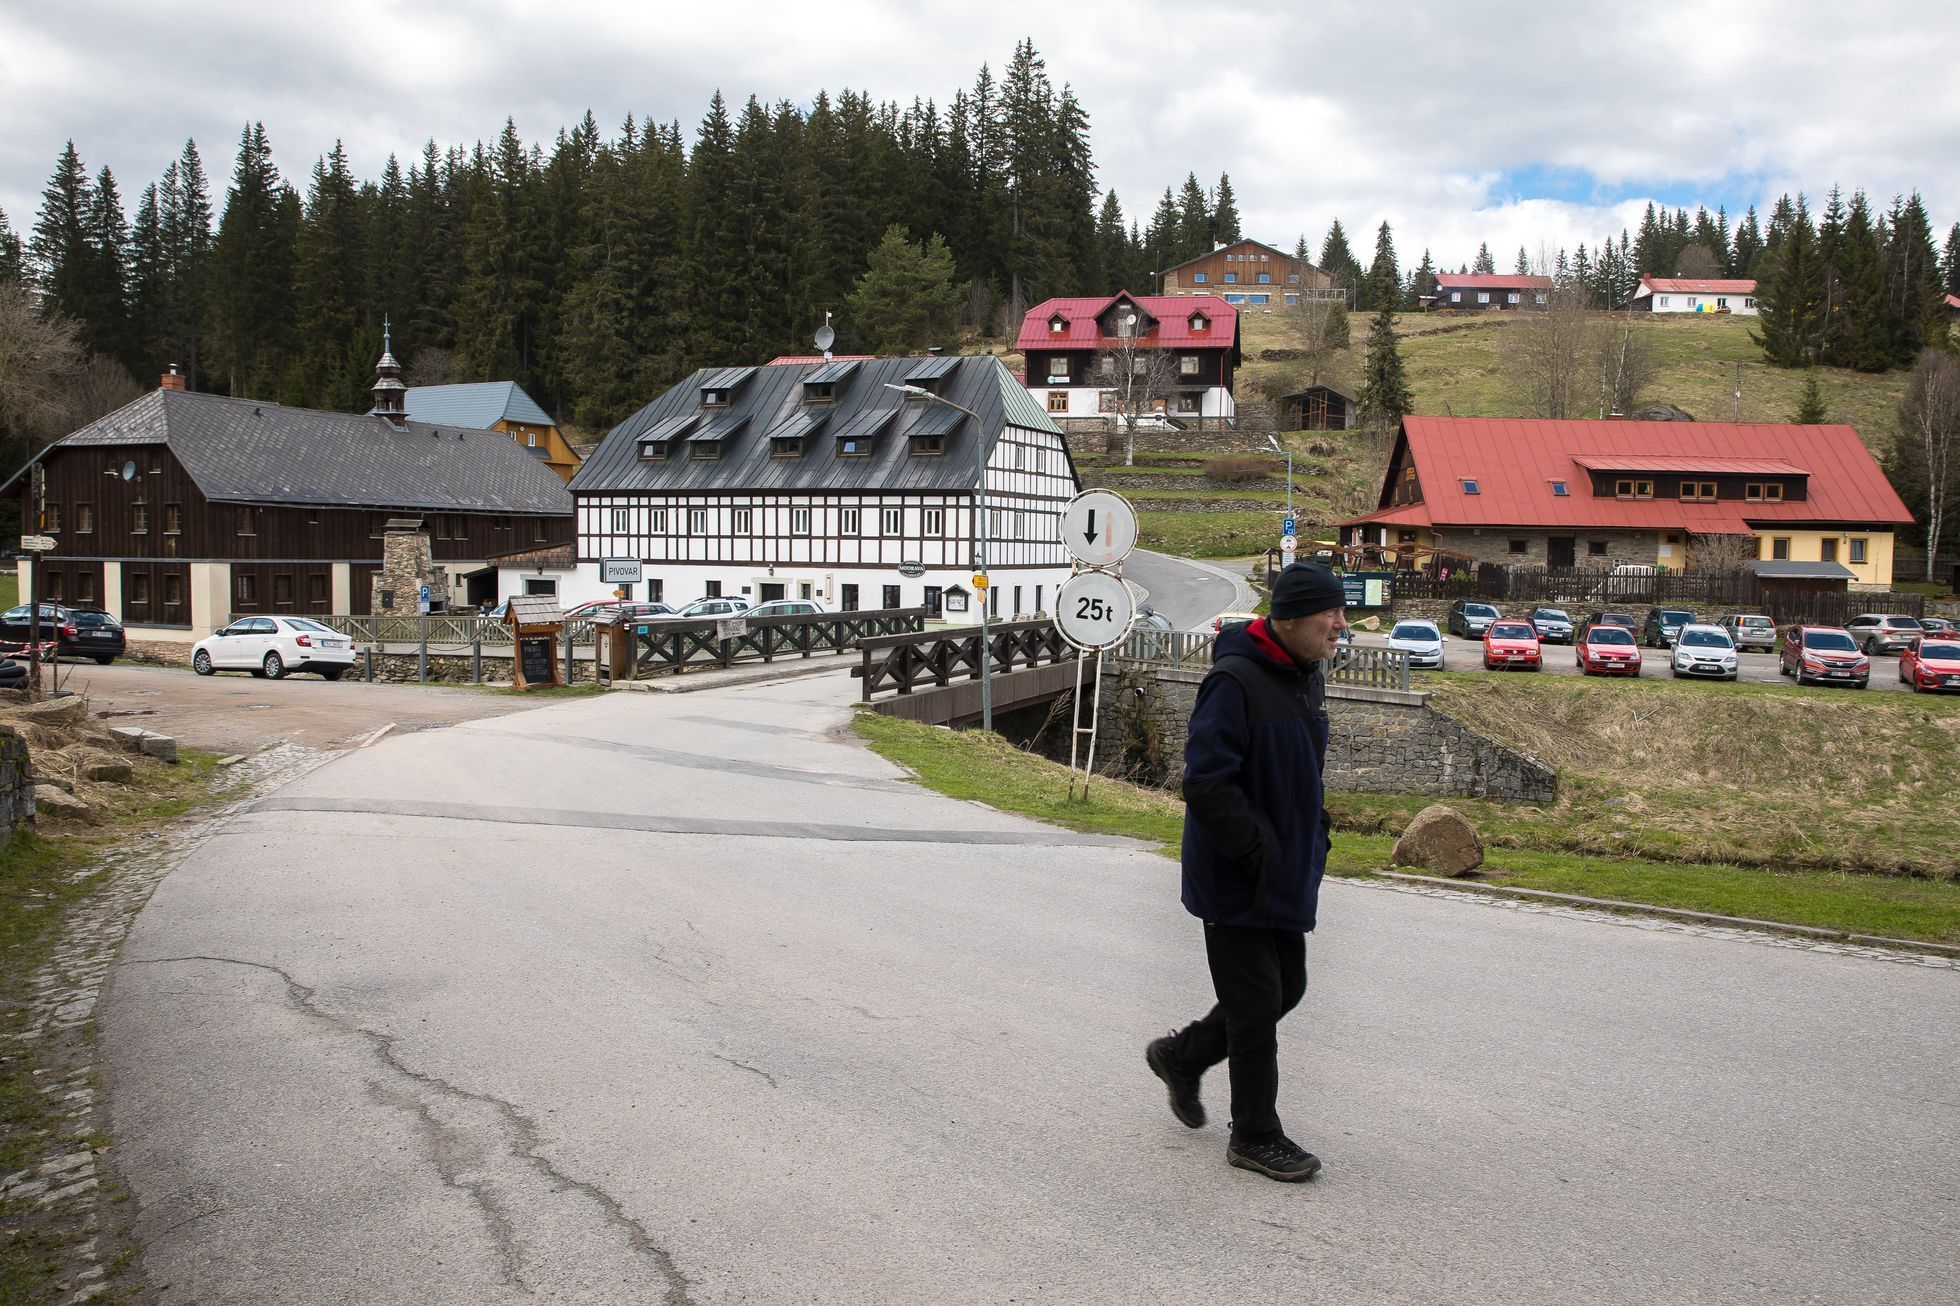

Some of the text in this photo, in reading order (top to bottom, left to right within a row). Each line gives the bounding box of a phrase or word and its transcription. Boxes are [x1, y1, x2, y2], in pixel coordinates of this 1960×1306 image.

[1285, 520, 1293, 530] P
[608, 567, 638, 576] PIVOVAR
[422, 587, 428, 597] P
